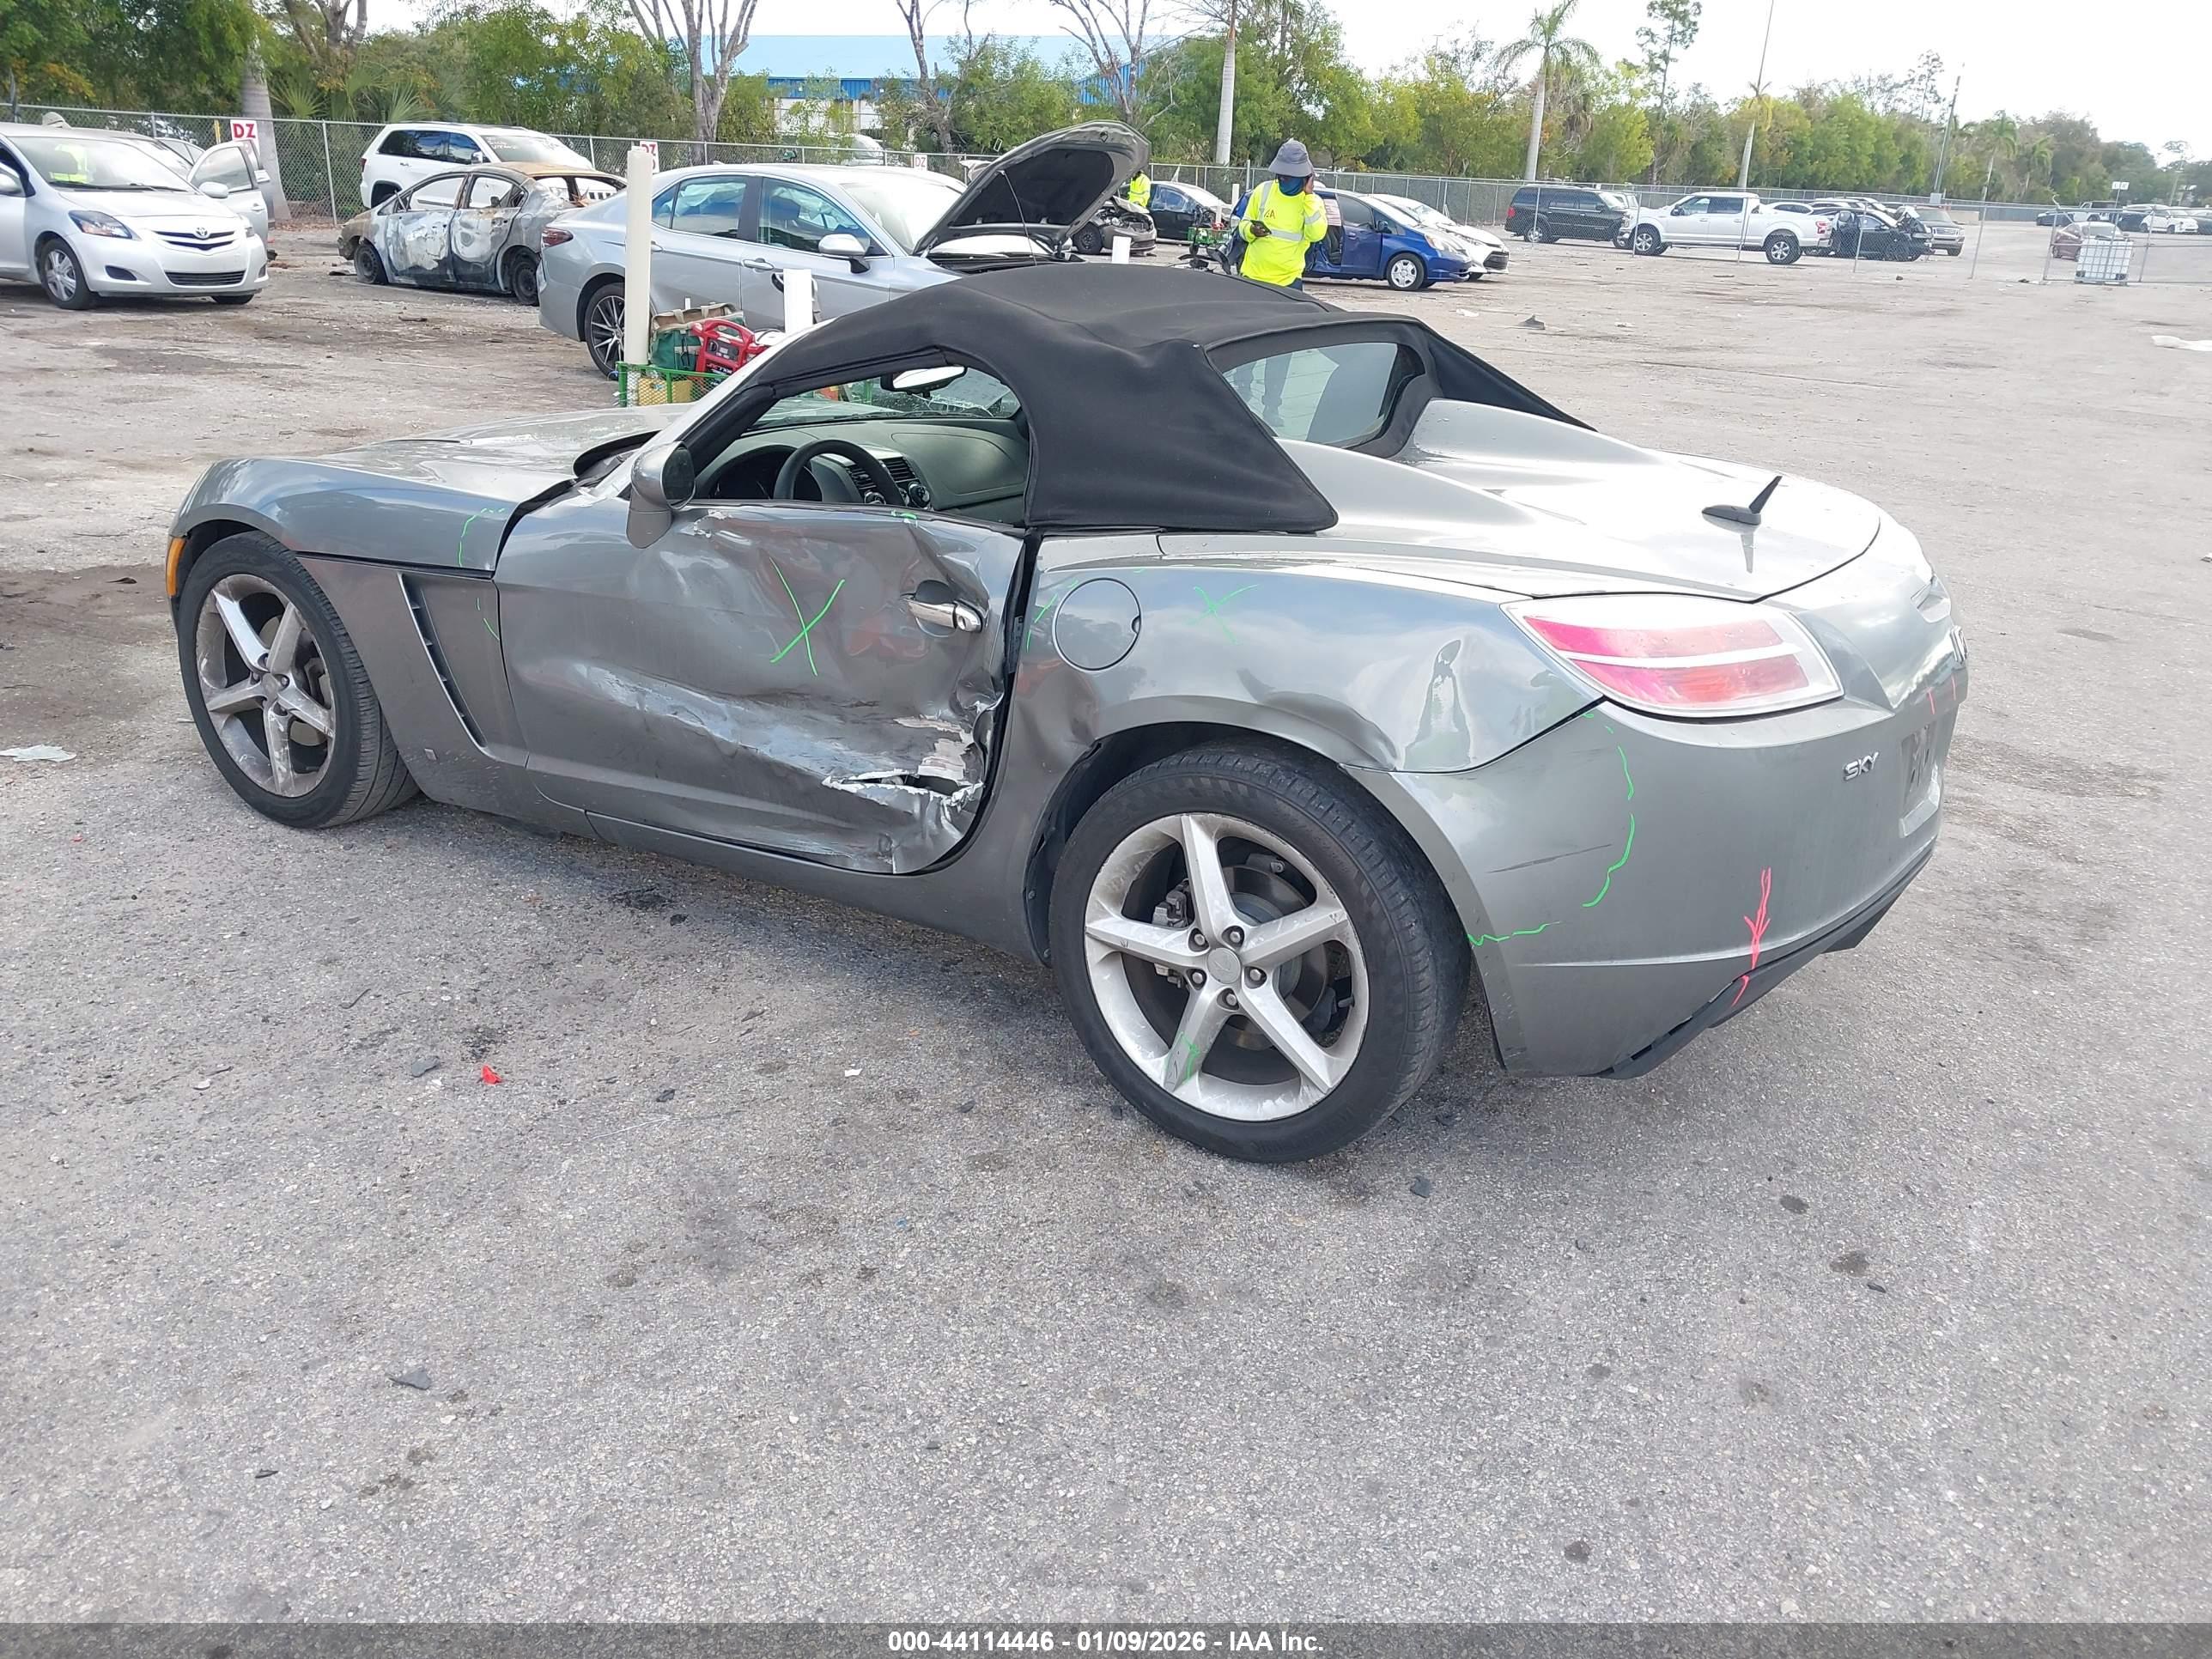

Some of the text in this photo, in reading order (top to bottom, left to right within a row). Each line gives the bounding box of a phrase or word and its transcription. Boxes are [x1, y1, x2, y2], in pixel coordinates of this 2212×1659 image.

[233, 123, 256, 138] DZ
[915, 156, 927, 167] DZ
[1844, 751, 1880, 781] SKY
